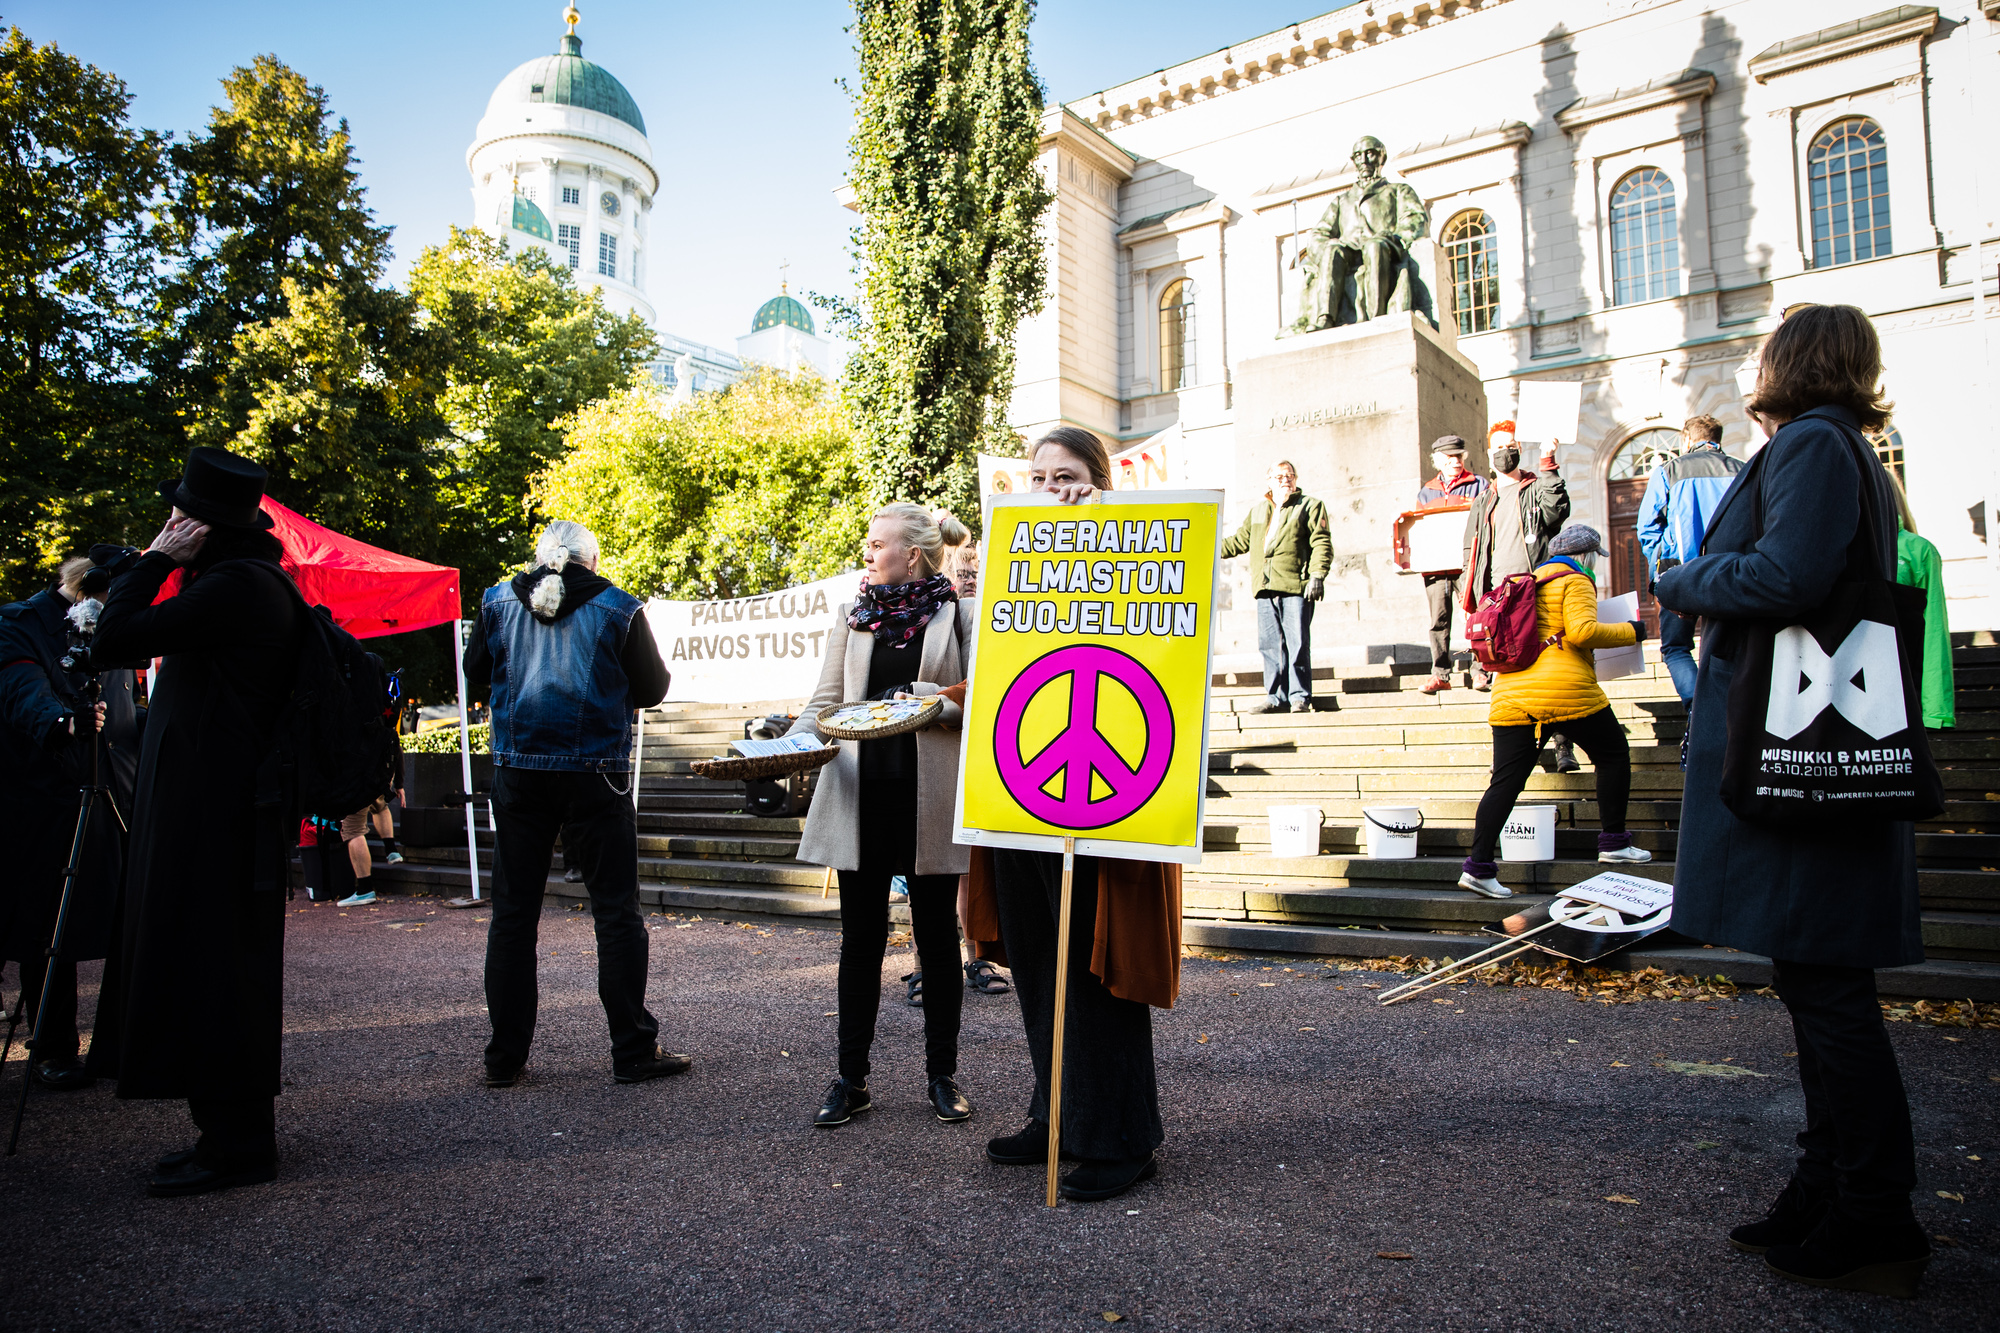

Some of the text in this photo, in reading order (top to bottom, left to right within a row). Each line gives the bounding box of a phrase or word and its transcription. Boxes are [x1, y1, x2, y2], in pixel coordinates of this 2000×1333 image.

[1009, 519, 1190, 553] ASERAHAT
[1007, 560, 1185, 594] ILMASTON
[691, 589, 829, 626] PALVELUJA
[991, 600, 1198, 637] SUOJELUUN
[1761, 748, 1913, 764] MUSIIKKI & MEDIA
[1760, 763, 1913, 776] 4.-5.10.2018 TAMPERE
[1756, 786, 1804, 799] LOST IN MUSIC
[1875, 790, 1915, 798] KAUPUNKI
